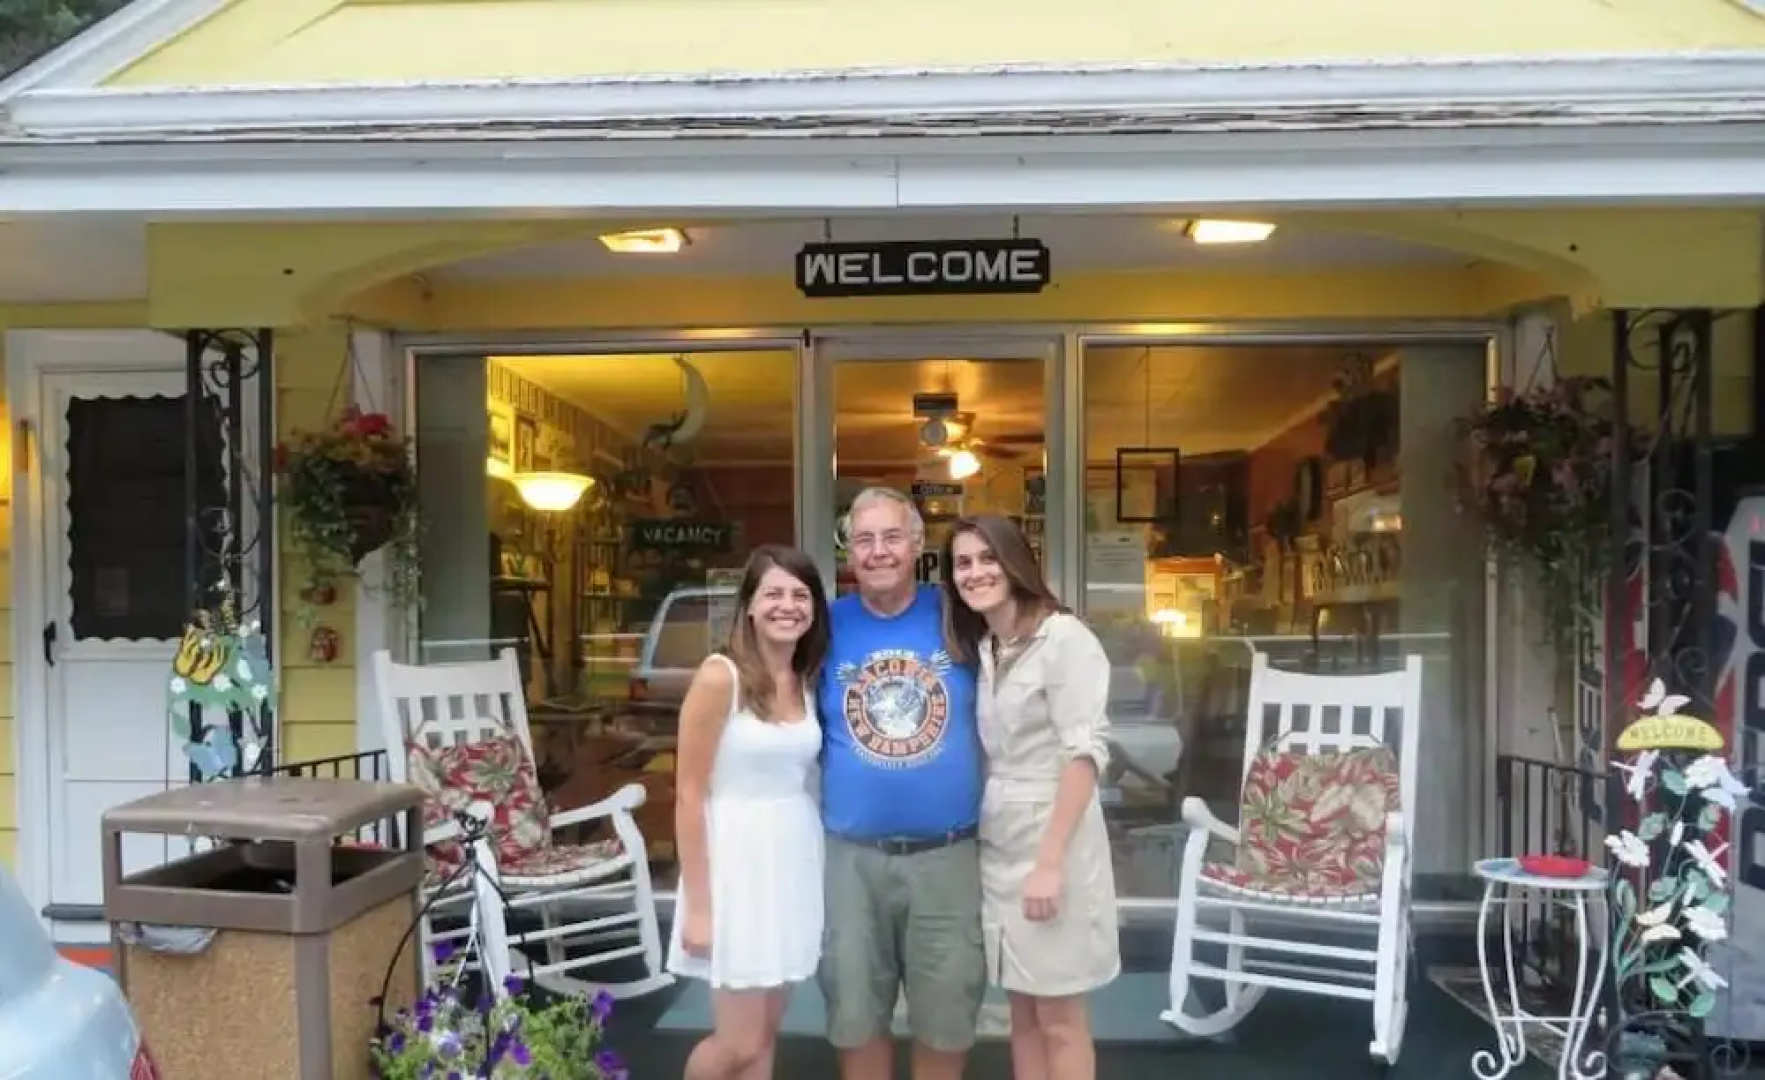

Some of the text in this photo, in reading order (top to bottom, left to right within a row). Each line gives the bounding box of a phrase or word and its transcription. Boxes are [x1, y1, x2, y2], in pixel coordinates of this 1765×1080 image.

[804, 249, 1042, 286] WELCOME
[642, 525, 722, 544] VACANCY
[1630, 722, 1709, 741] WELCOME
